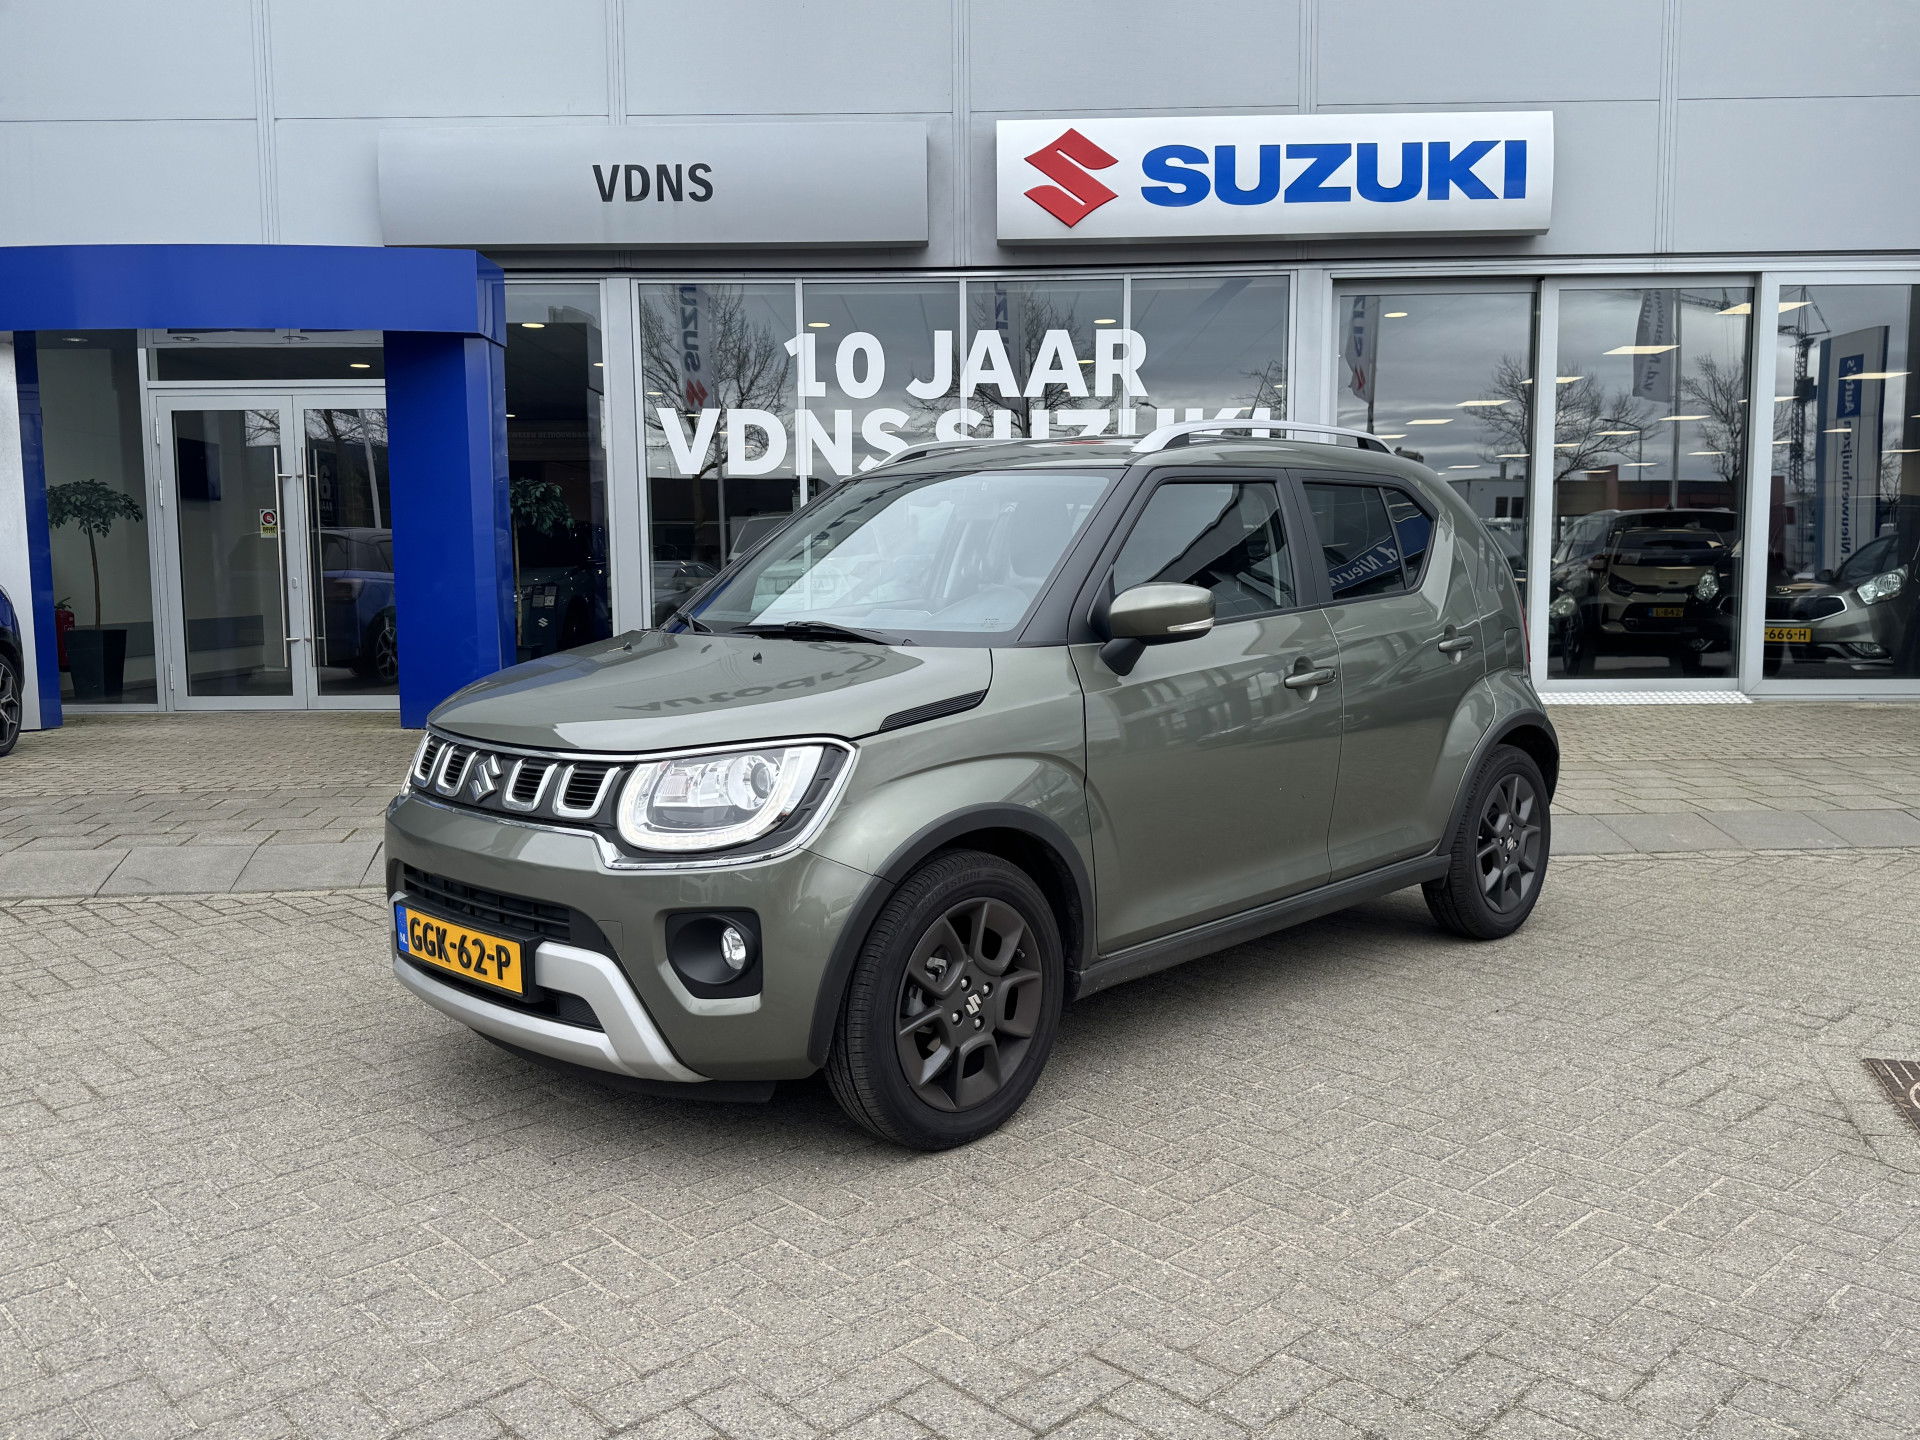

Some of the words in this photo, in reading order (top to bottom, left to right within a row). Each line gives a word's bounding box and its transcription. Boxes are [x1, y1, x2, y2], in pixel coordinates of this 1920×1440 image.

[592, 162, 714, 203] VDNS
[1140, 139, 1527, 207] SUZUKI
[783, 331, 886, 400] 10
[905, 328, 1149, 400] JAAR
[656, 407, 911, 476] VDNS
[409, 916, 511, 980] GGK-62-P
